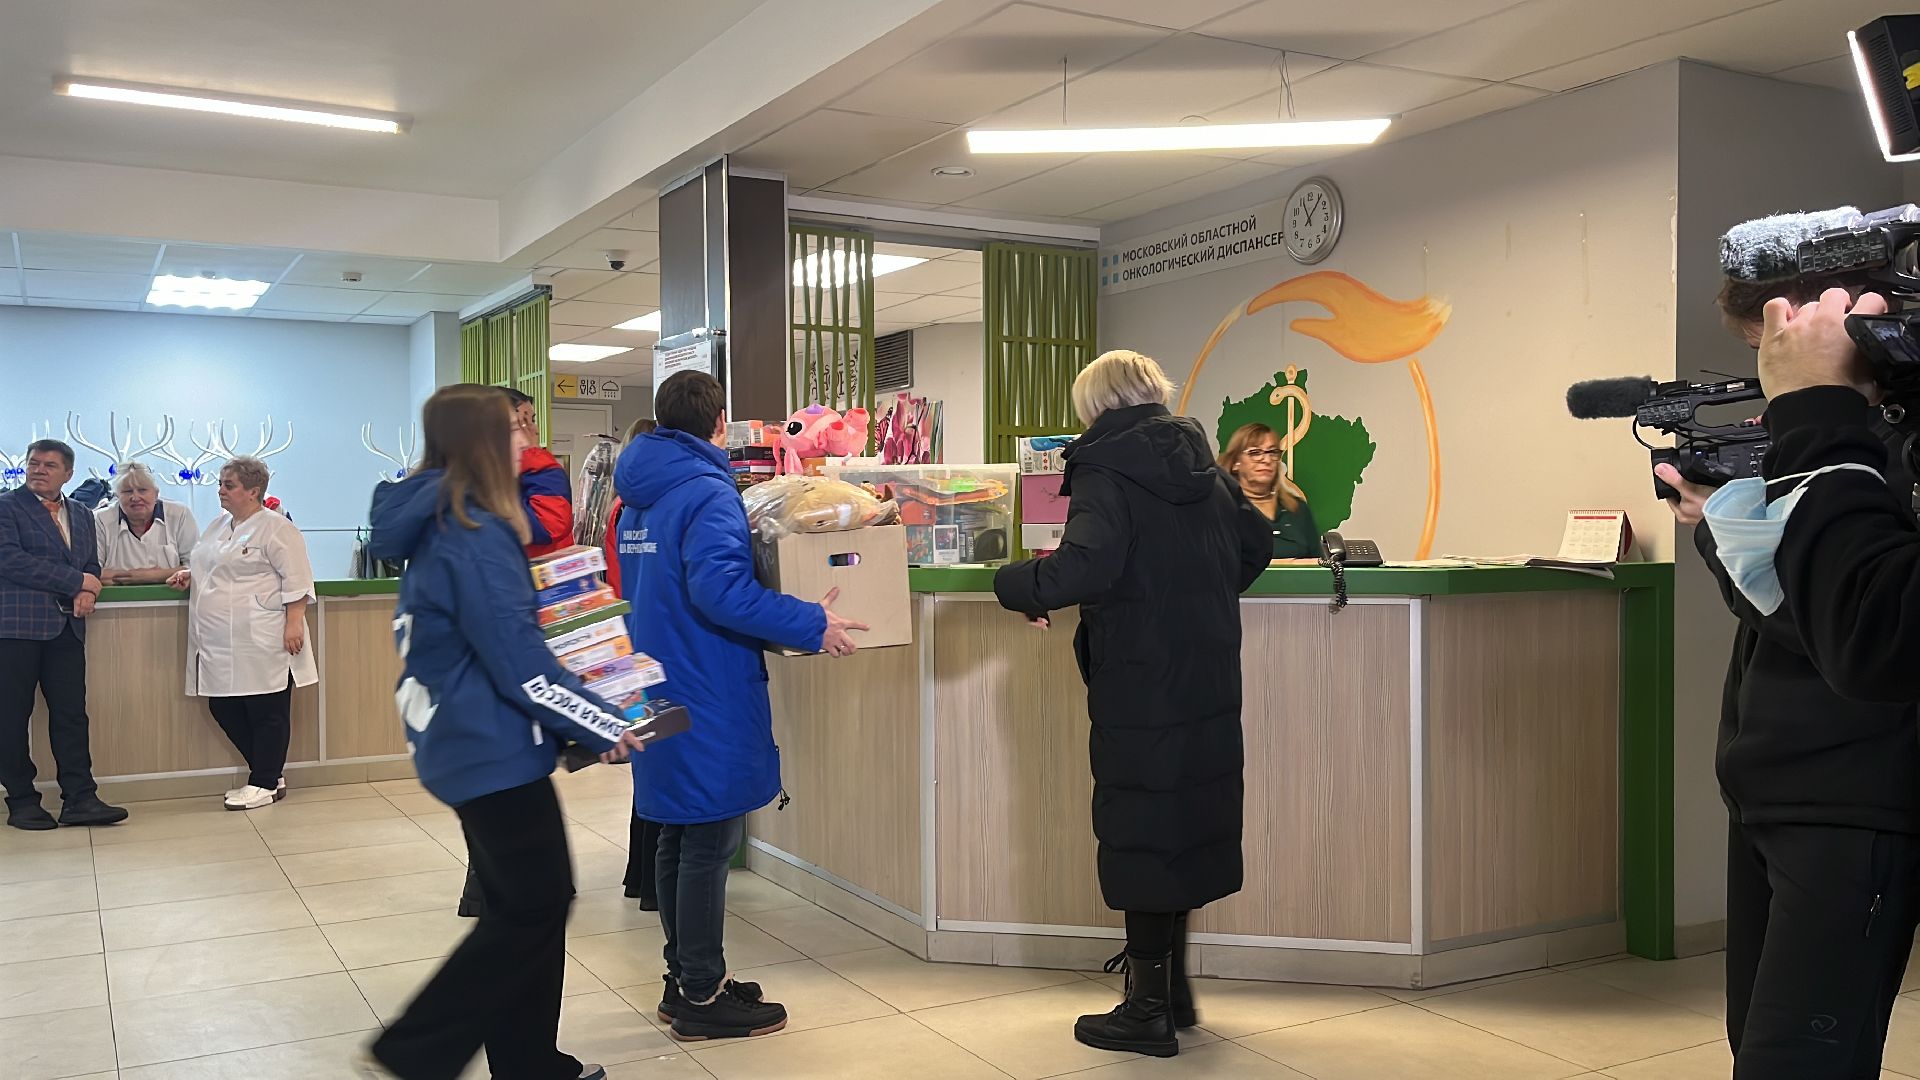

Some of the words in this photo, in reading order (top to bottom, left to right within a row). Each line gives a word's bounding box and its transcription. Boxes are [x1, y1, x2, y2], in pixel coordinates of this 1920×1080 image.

[1308, 192, 1313, 201] 12
[1321, 201, 1326, 210] 2
[1294, 208, 1300, 217] 10
[1323, 212, 1328, 221] 3
[1292, 220, 1297, 228] 9
[1123, 233, 1188, 263] МОСКОВСКИЙ
[1190, 215, 1256, 245] ОБЛАСТНОЙ
[1294, 231, 1299, 239] 8
[1316, 235, 1320, 243] 5
[1300, 238, 1304, 247] 7
[1308, 239, 1312, 248] 6
[1123, 246, 1215, 281] ОНКОЛОГИЧЕСКИЙ
[579, 706, 625, 737] ДИНАЯ
